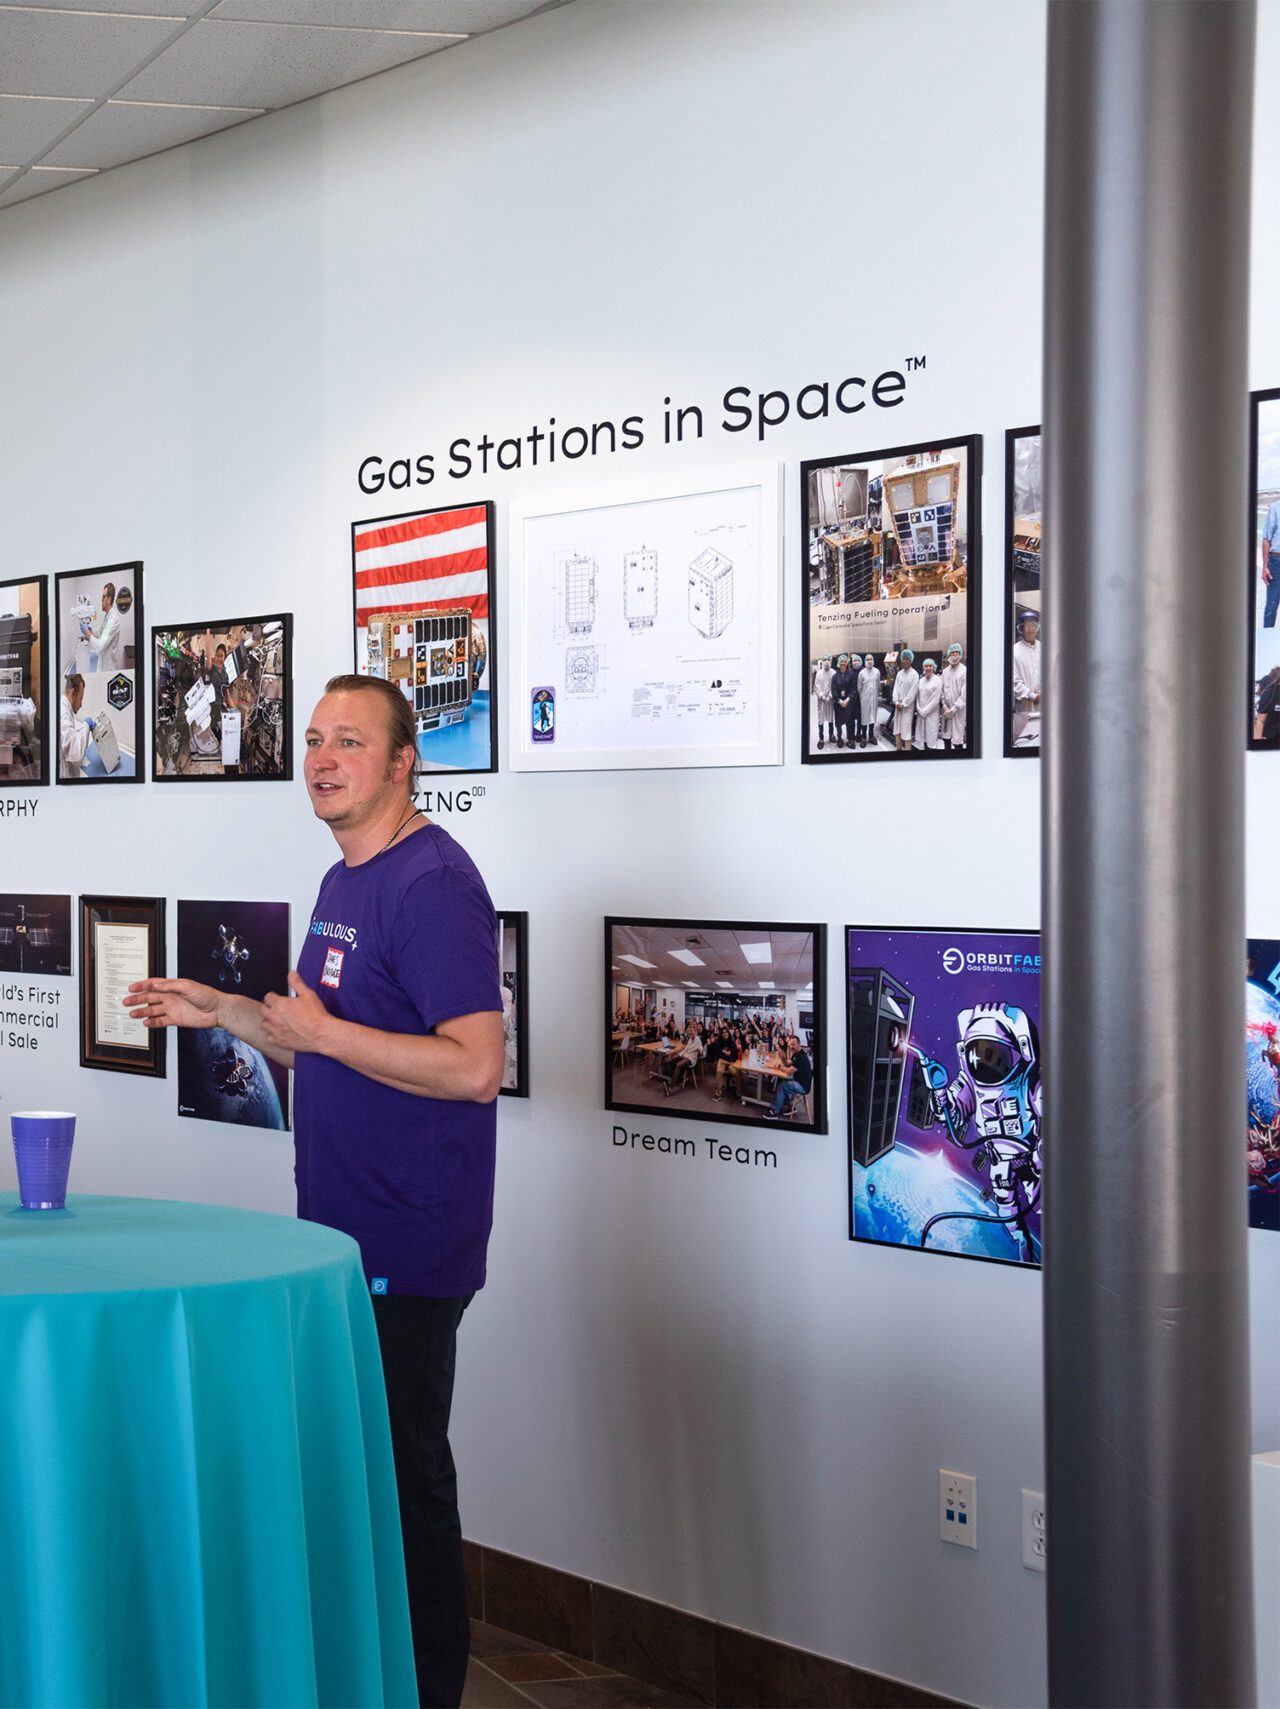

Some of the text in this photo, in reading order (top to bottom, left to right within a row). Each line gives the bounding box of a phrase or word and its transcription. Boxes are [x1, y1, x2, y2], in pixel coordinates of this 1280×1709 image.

[358, 456, 435, 495] Gas
[448, 416, 645, 479] Stations
[664, 396, 703, 444] in
[817, 604, 946, 622] Tenzing Fueling Operations
[28, 987, 61, 1005] First
[8, 1031, 38, 1050] Sale
[612, 1125, 777, 1168] Dream Team
